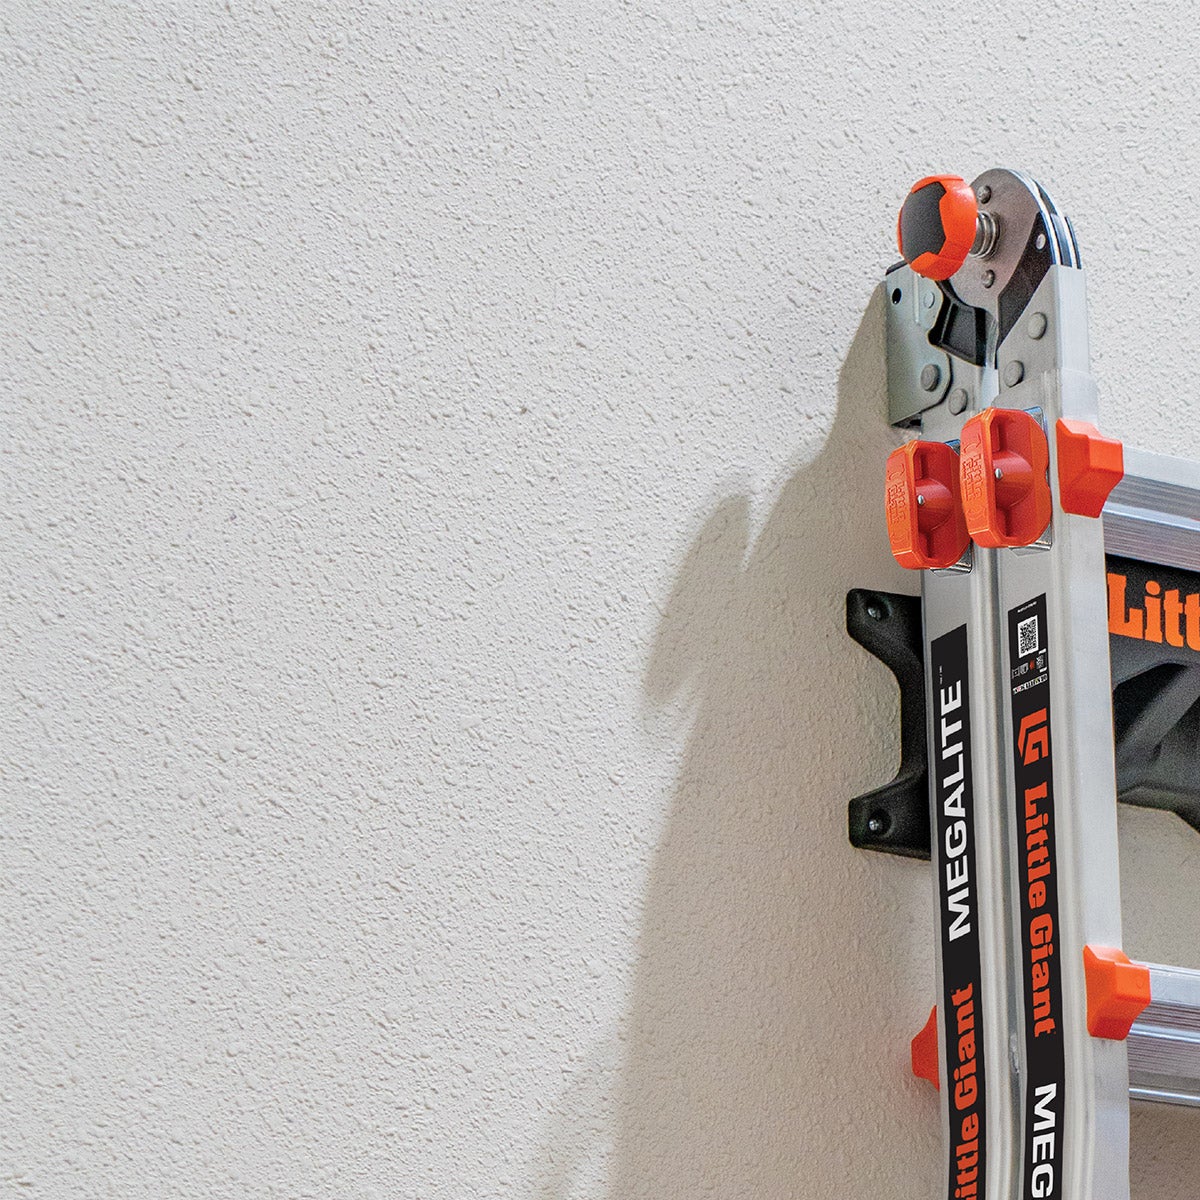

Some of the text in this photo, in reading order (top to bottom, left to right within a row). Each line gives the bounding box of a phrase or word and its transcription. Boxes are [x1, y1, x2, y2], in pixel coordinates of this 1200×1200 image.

[940, 680, 971, 942] MEGALITE
[1024, 781, 1051, 909] Little
[1029, 913, 1056, 1037] Giant
[951, 983, 978, 1110] Giant
